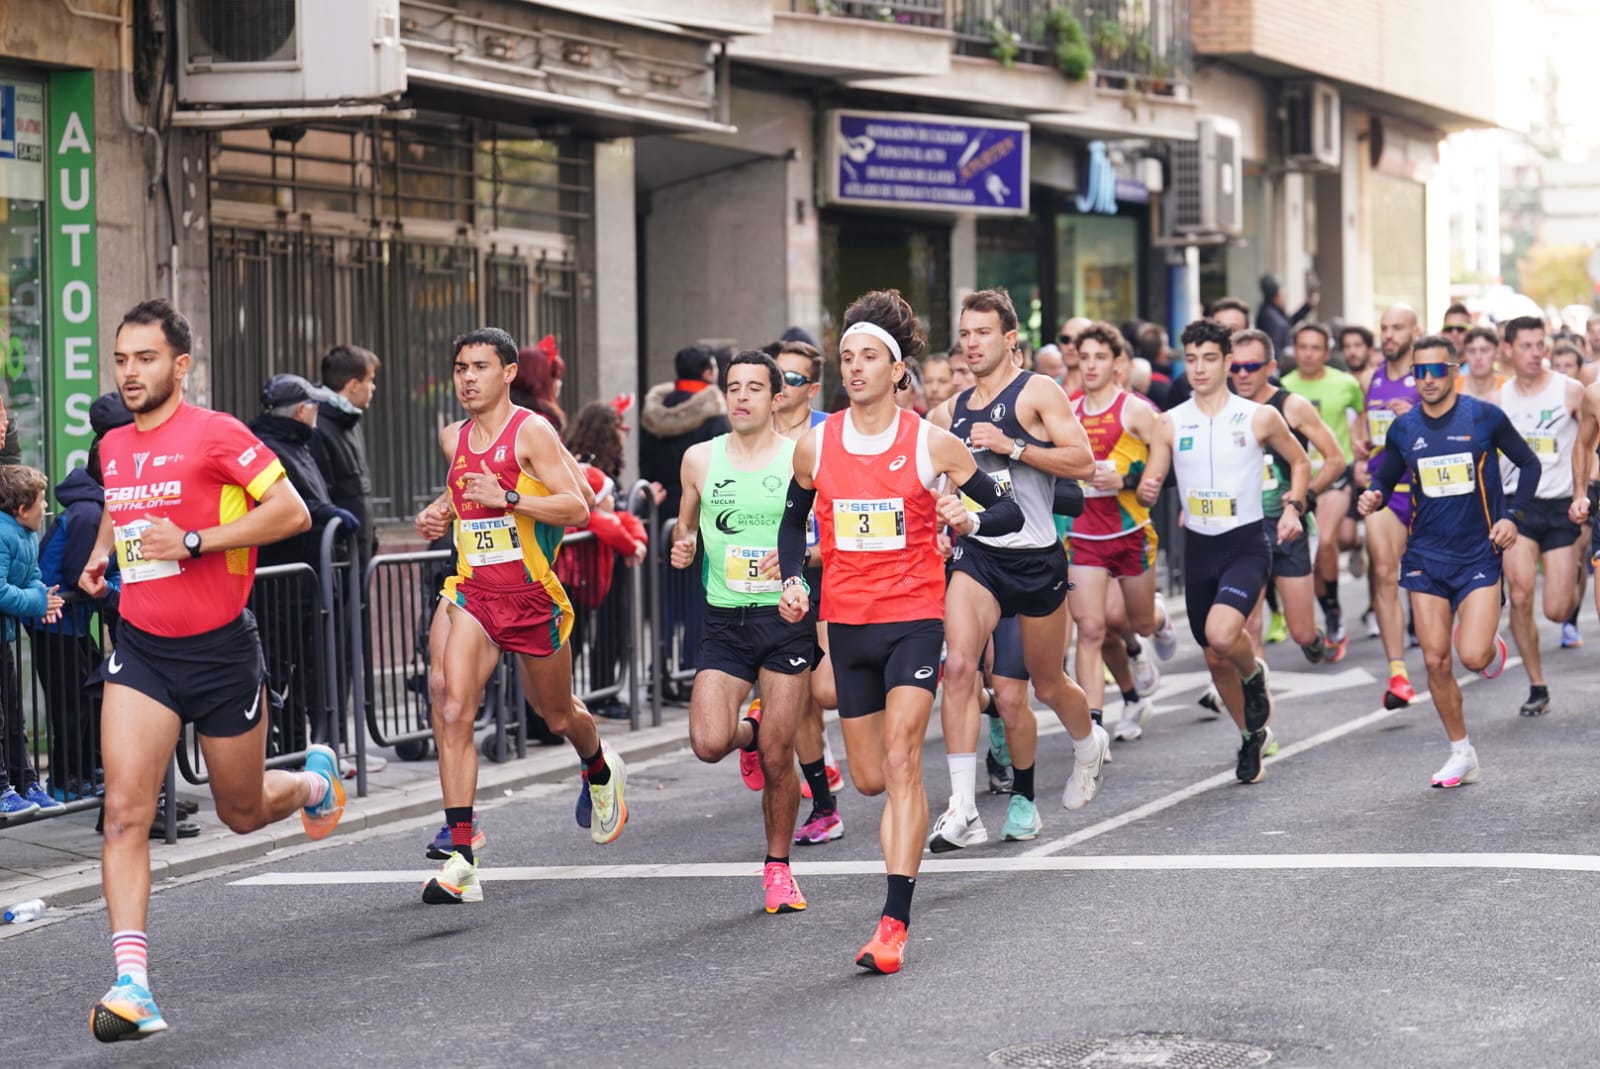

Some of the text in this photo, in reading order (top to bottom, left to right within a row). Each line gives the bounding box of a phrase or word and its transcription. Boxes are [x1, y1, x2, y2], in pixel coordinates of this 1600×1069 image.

[57, 111, 93, 469] AUTOES
[1432, 457, 1468, 466] SETEL
[1437, 467, 1450, 482] 14
[851, 502, 896, 511] SETEL
[1201, 499, 1214, 515] 81
[471, 519, 510, 530] SETEL
[859, 514, 870, 533] 3
[475, 531, 494, 550] 25
[742, 550, 769, 558] SET
[749, 559, 758, 577] 5
